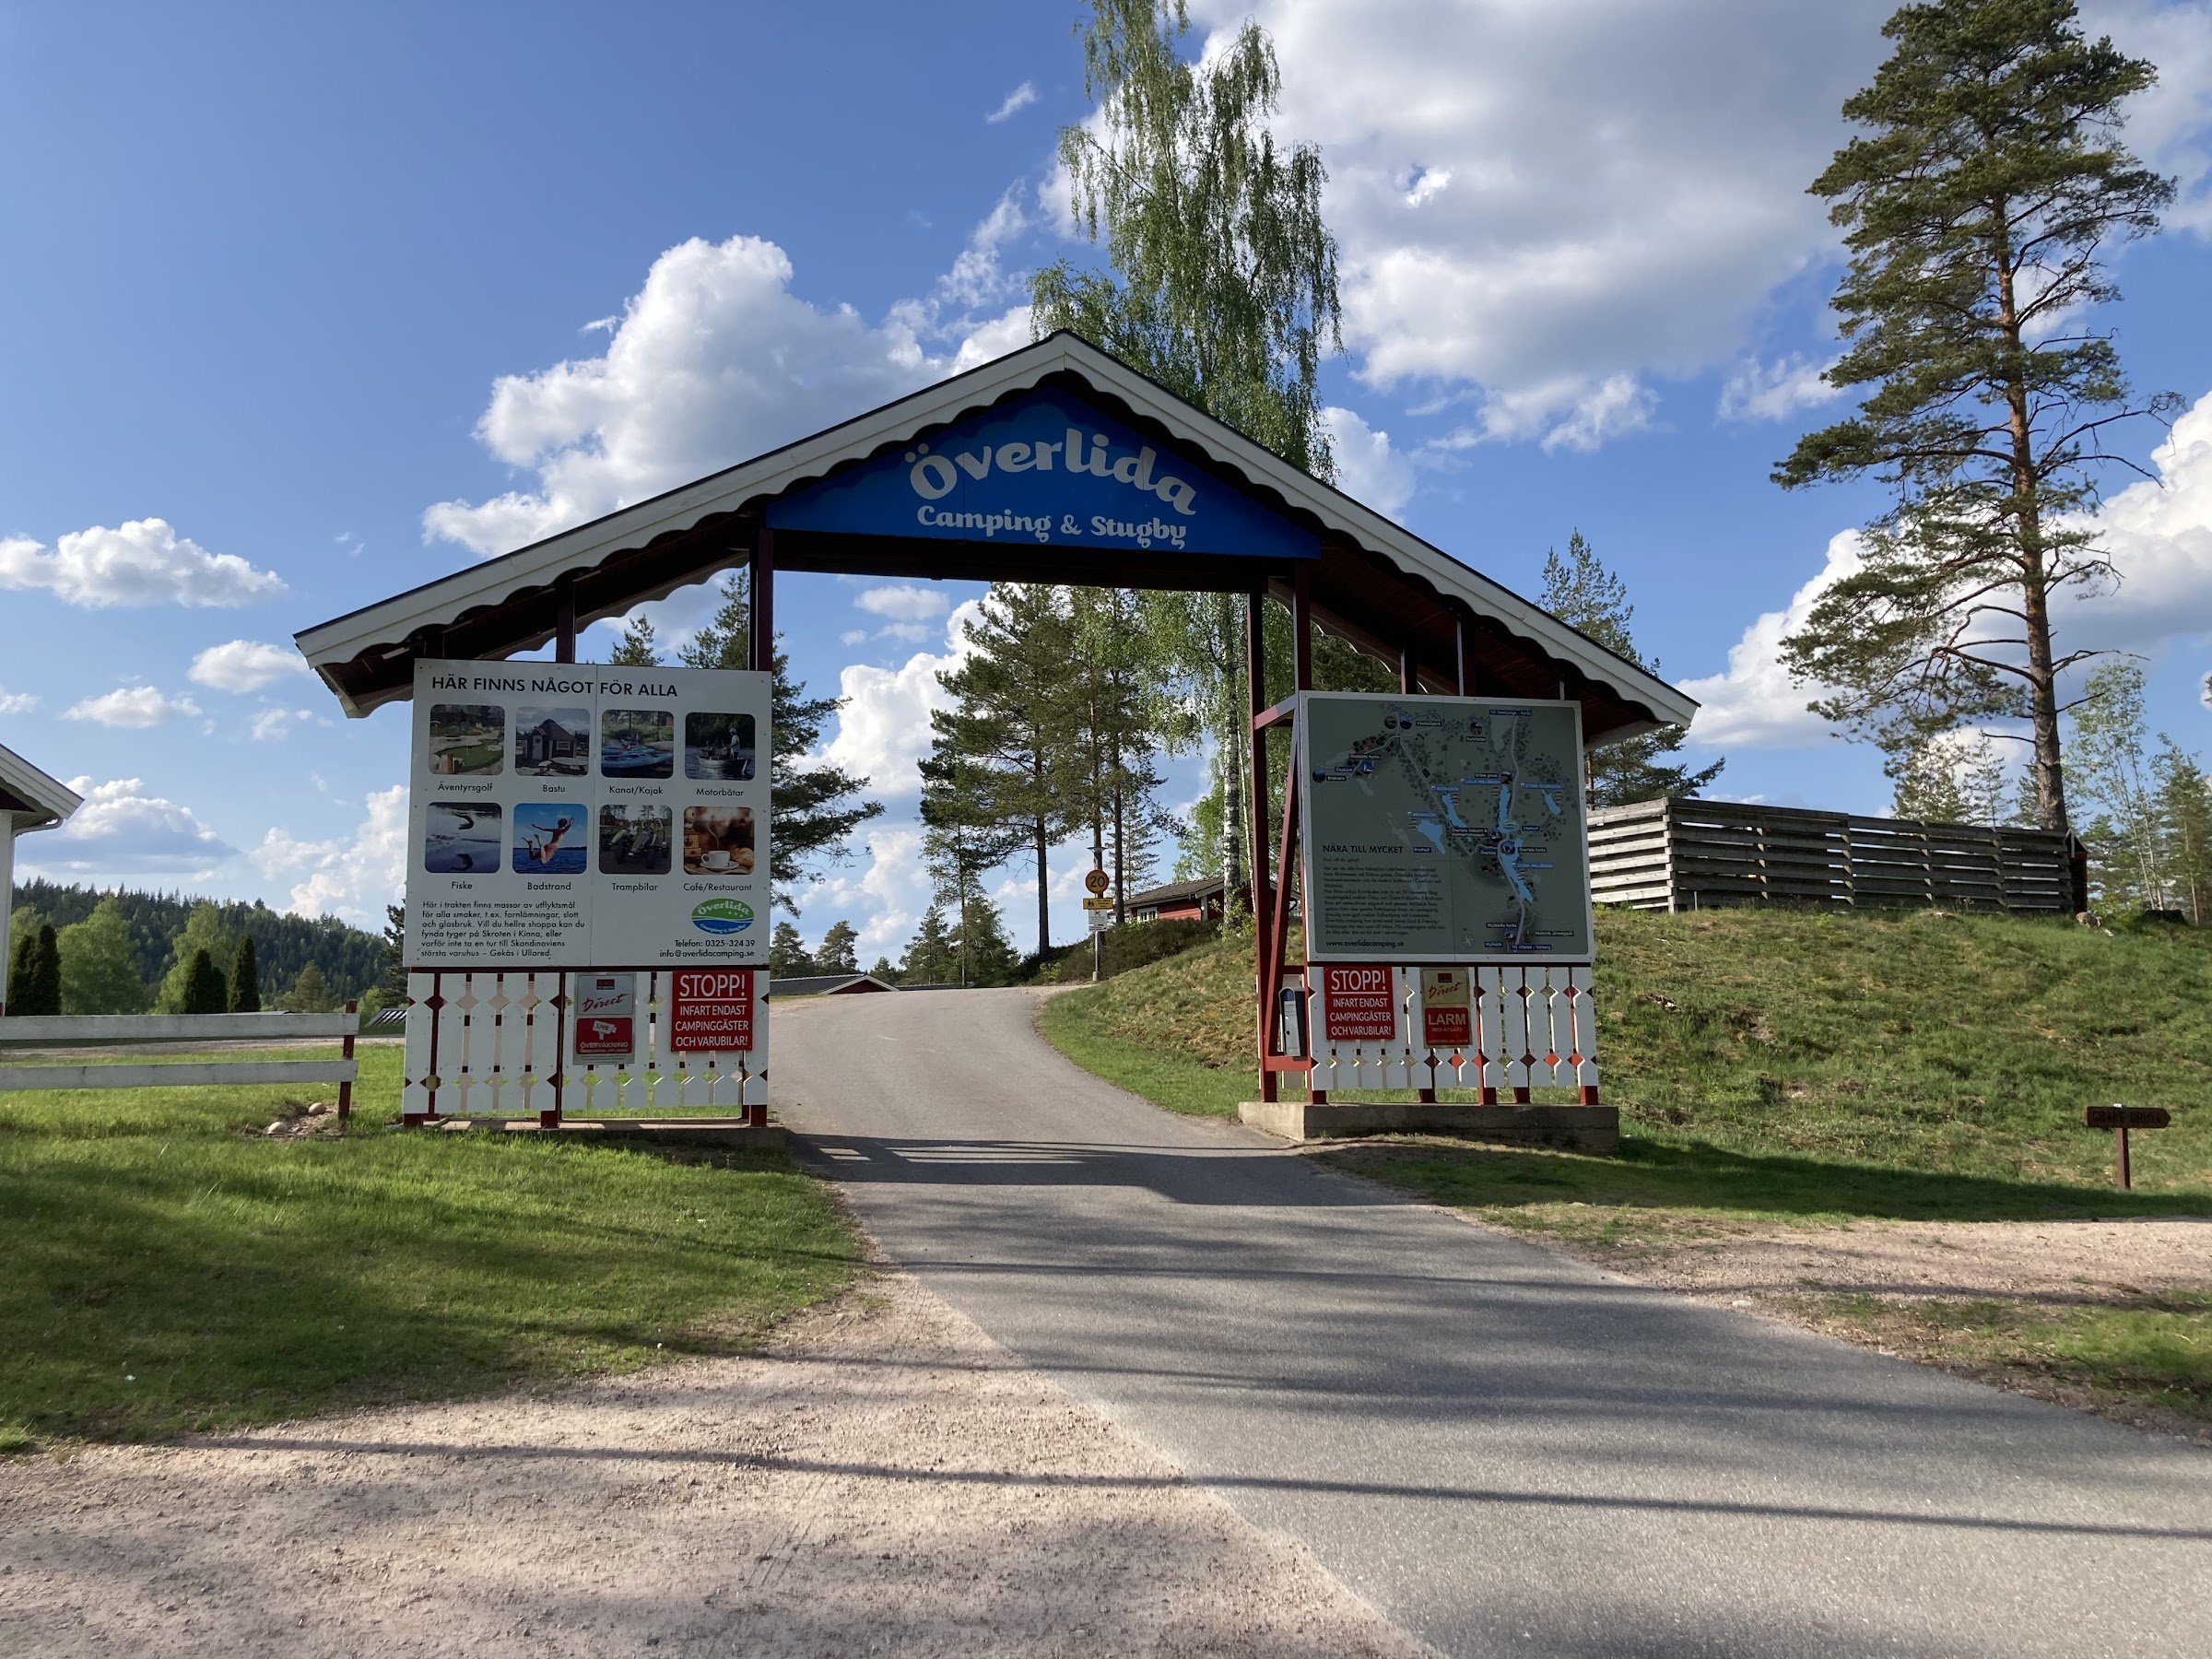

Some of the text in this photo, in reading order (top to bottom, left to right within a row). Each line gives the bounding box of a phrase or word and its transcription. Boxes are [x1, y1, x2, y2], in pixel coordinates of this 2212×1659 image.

[905, 428, 1196, 516] Överlida
[917, 505, 1186, 549] Camping & Stugby
[432, 673, 678, 697] HÄR FINNS NÅGOT FÖR ALLA
[437, 782, 494, 794] Äventyrsgolf
[542, 783, 566, 793] Bastu
[608, 784, 664, 796] Kanot/Kajak
[696, 787, 745, 797] Motorbåtar
[1349, 845, 1367, 853] TILL
[1369, 845, 1403, 853] MYCKET
[451, 881, 473, 890] Fiske
[526, 881, 571, 891] Badstrand
[611, 882, 659, 893] Trampbilar
[682, 882, 753, 892] Café/Restaurant
[1089, 876, 1105, 888] 20
[535, 901, 575, 910] utflyktsmål
[697, 900, 749, 914] Överlida
[504, 911, 560, 919] fornlämningar,
[439, 921, 475, 929] glasbruk.
[528, 921, 557, 929] shoppa
[421, 930, 444, 938] fynda
[469, 930, 479, 938] på
[518, 930, 543, 938] Kinna,
[675, 939, 702, 947] Telefon:
[659, 949, 754, 959] info@overlidacamping.se
[678, 974, 747, 997] STOPP!
[1331, 970, 1386, 991] STOPP!
[1333, 997, 1387, 1008] INFART ENDAST
[680, 1005, 747, 1016] INFART ENDAST
[1329, 1011, 1392, 1022] CAMPINGGÄSTER
[1429, 1014, 1465, 1025] LARM
[675, 1019, 748, 1031] CAMPINGGÄSTER
[1331, 1025, 1392, 1036] OCH VARUBILAR!
[676, 1034, 748, 1047] OCH VARUBILAR!
